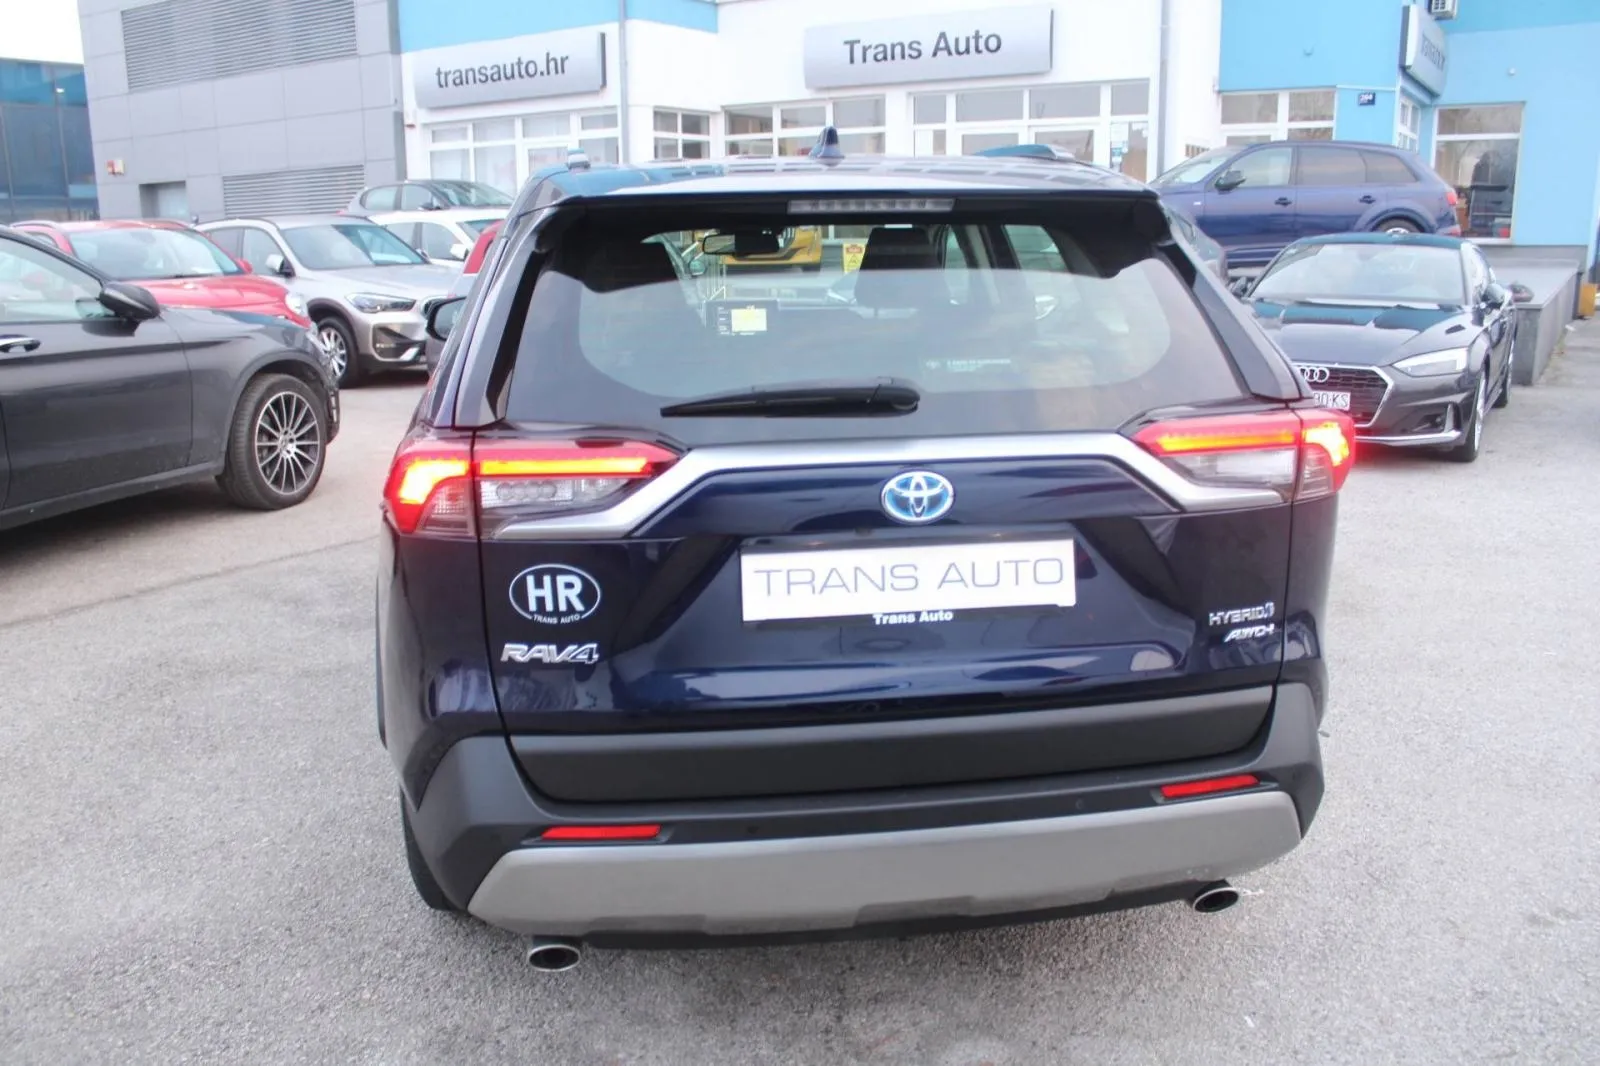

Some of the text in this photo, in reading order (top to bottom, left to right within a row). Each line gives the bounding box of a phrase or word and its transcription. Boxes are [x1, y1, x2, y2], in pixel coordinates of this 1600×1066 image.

[843, 29, 1002, 65] Trans Auto
[435, 51, 569, 88] transauto.hr
[754, 558, 1064, 597] TRANS AUTO
[526, 574, 585, 612] HR
[533, 613, 581, 625] TRANS AUTO
[872, 609, 954, 625] Trans Auto
[1208, 605, 1265, 626] HYBRID
[500, 642, 599, 664] RAV4
